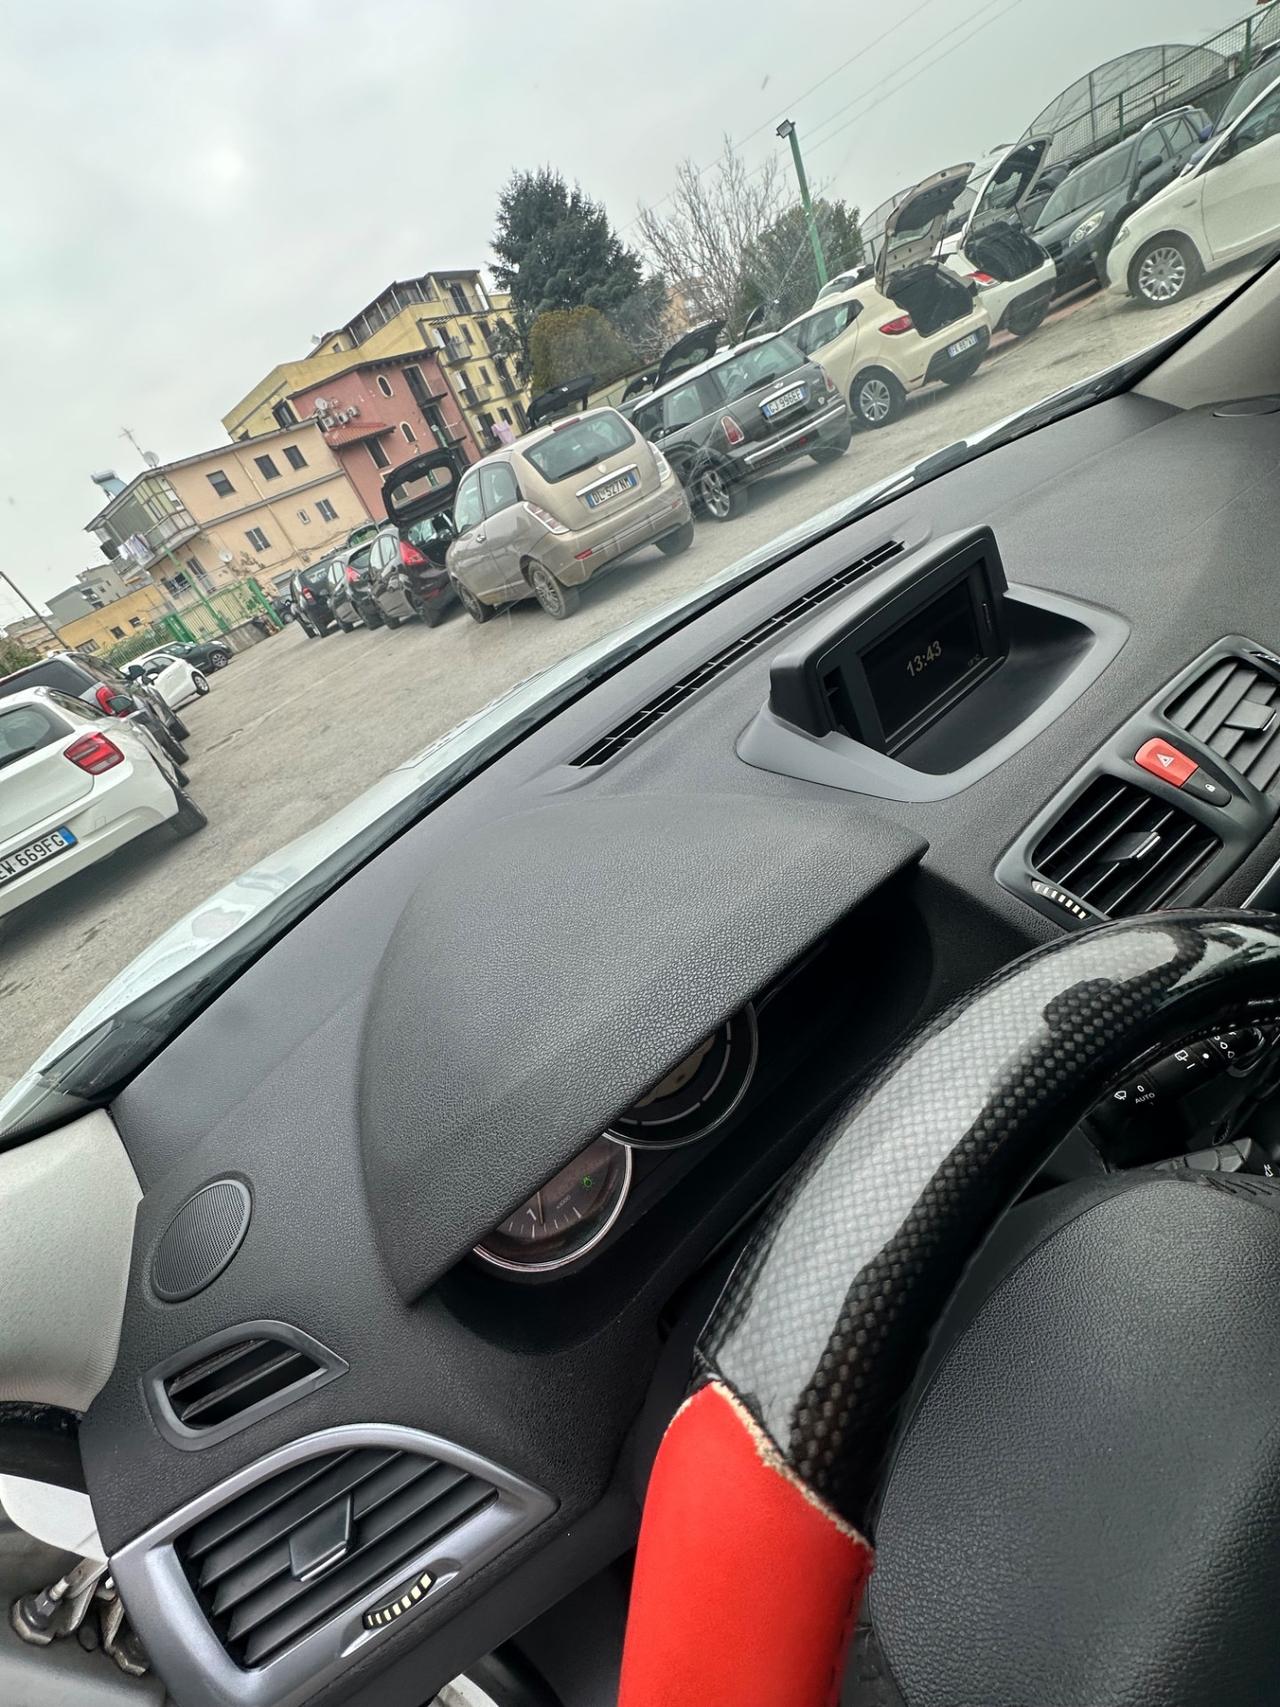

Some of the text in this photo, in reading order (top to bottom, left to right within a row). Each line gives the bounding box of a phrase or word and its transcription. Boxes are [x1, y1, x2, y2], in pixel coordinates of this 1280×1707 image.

[906, 640, 941, 677] 13:43
[15, 834, 65, 867] 669FG
[1135, 1092, 1155, 1104] AUTO
[526, 1207, 537, 1221] 1
